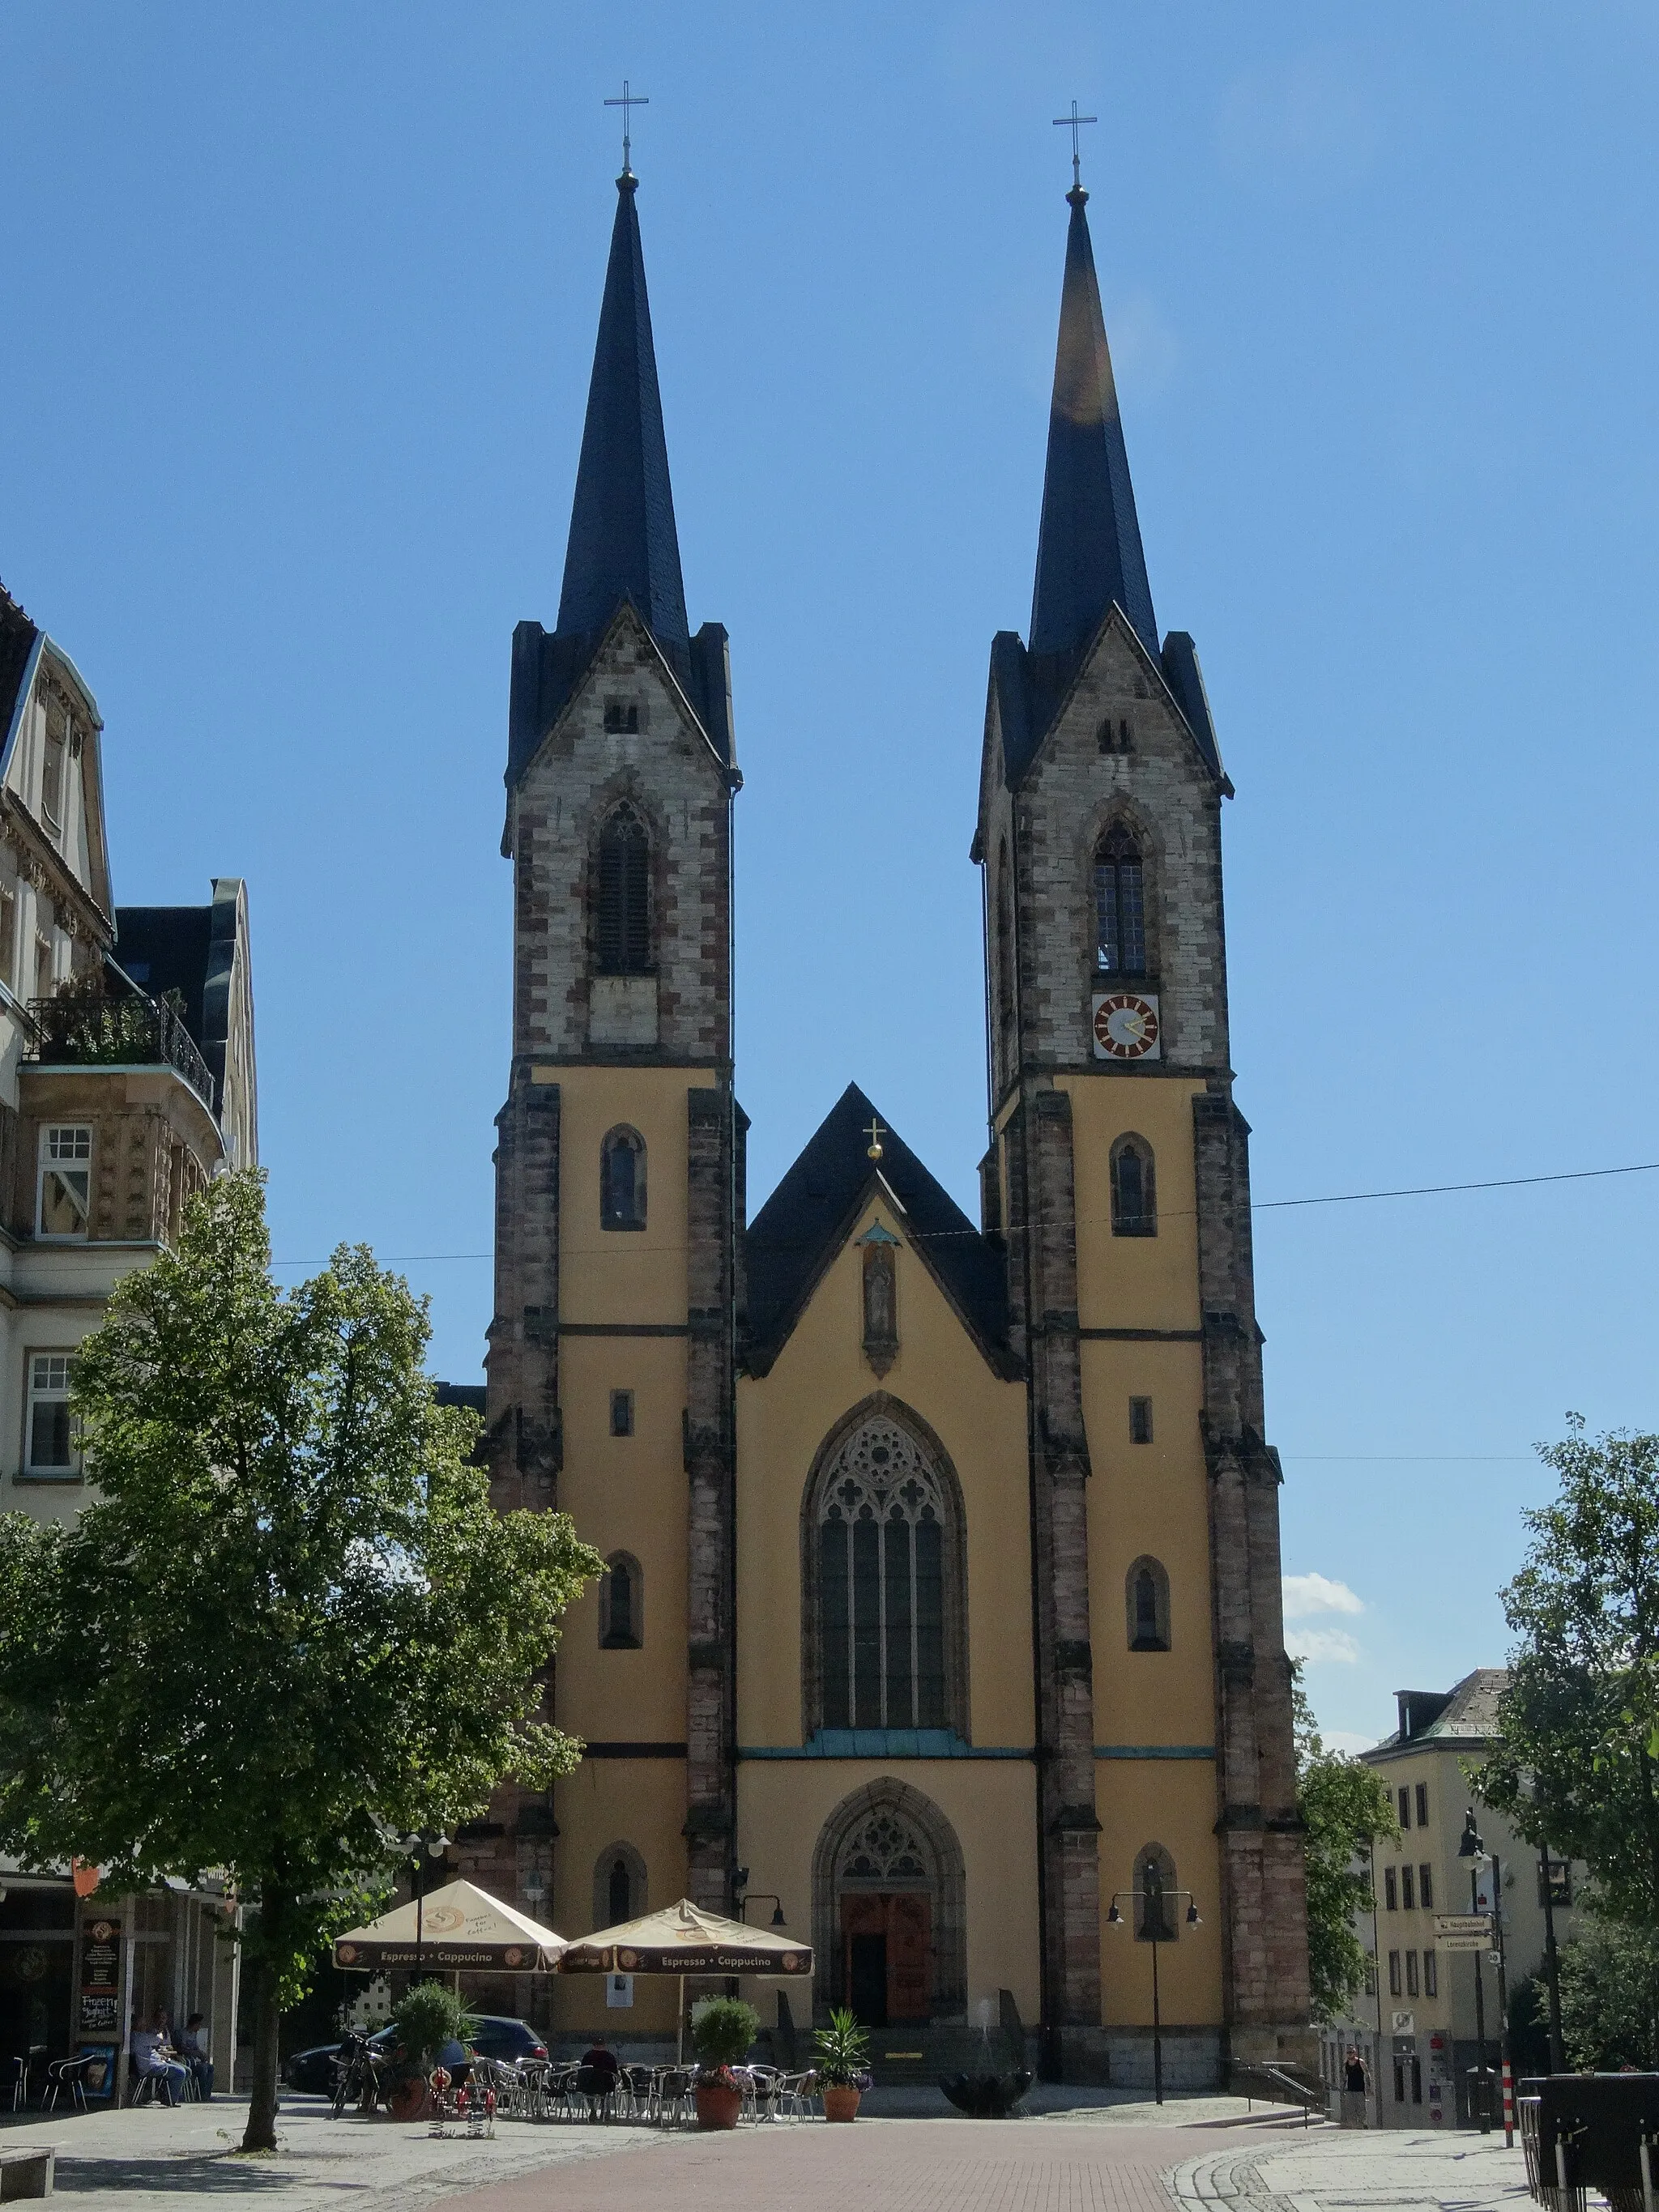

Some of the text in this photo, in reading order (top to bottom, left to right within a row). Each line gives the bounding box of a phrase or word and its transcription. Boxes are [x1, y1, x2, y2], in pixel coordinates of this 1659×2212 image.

[437, 1951, 492, 1963] Cappucino
[662, 1956, 770, 1967] Espresso Cappucino
